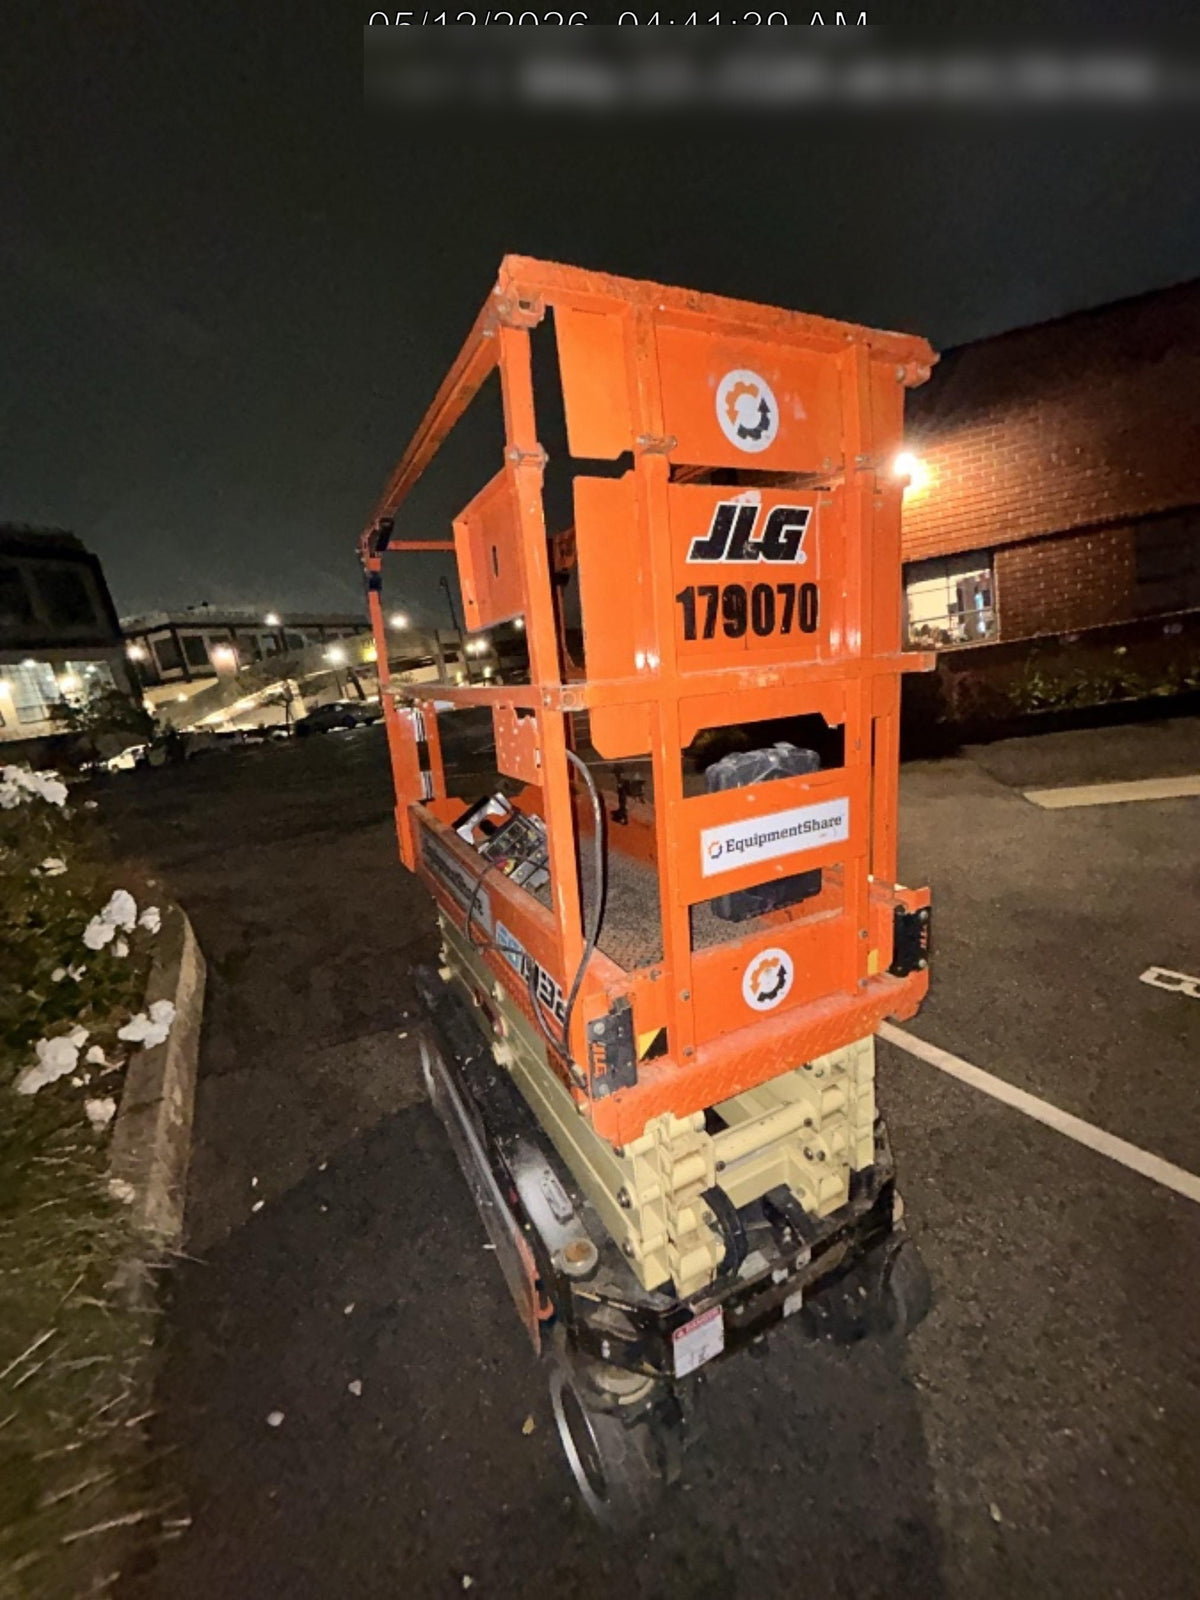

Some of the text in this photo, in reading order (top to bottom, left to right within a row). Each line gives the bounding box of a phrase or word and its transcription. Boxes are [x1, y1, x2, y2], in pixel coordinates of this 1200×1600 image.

[687, 503, 811, 562] JLG
[676, 582, 818, 640] 179070
[726, 815, 842, 853] EquipmentShare
